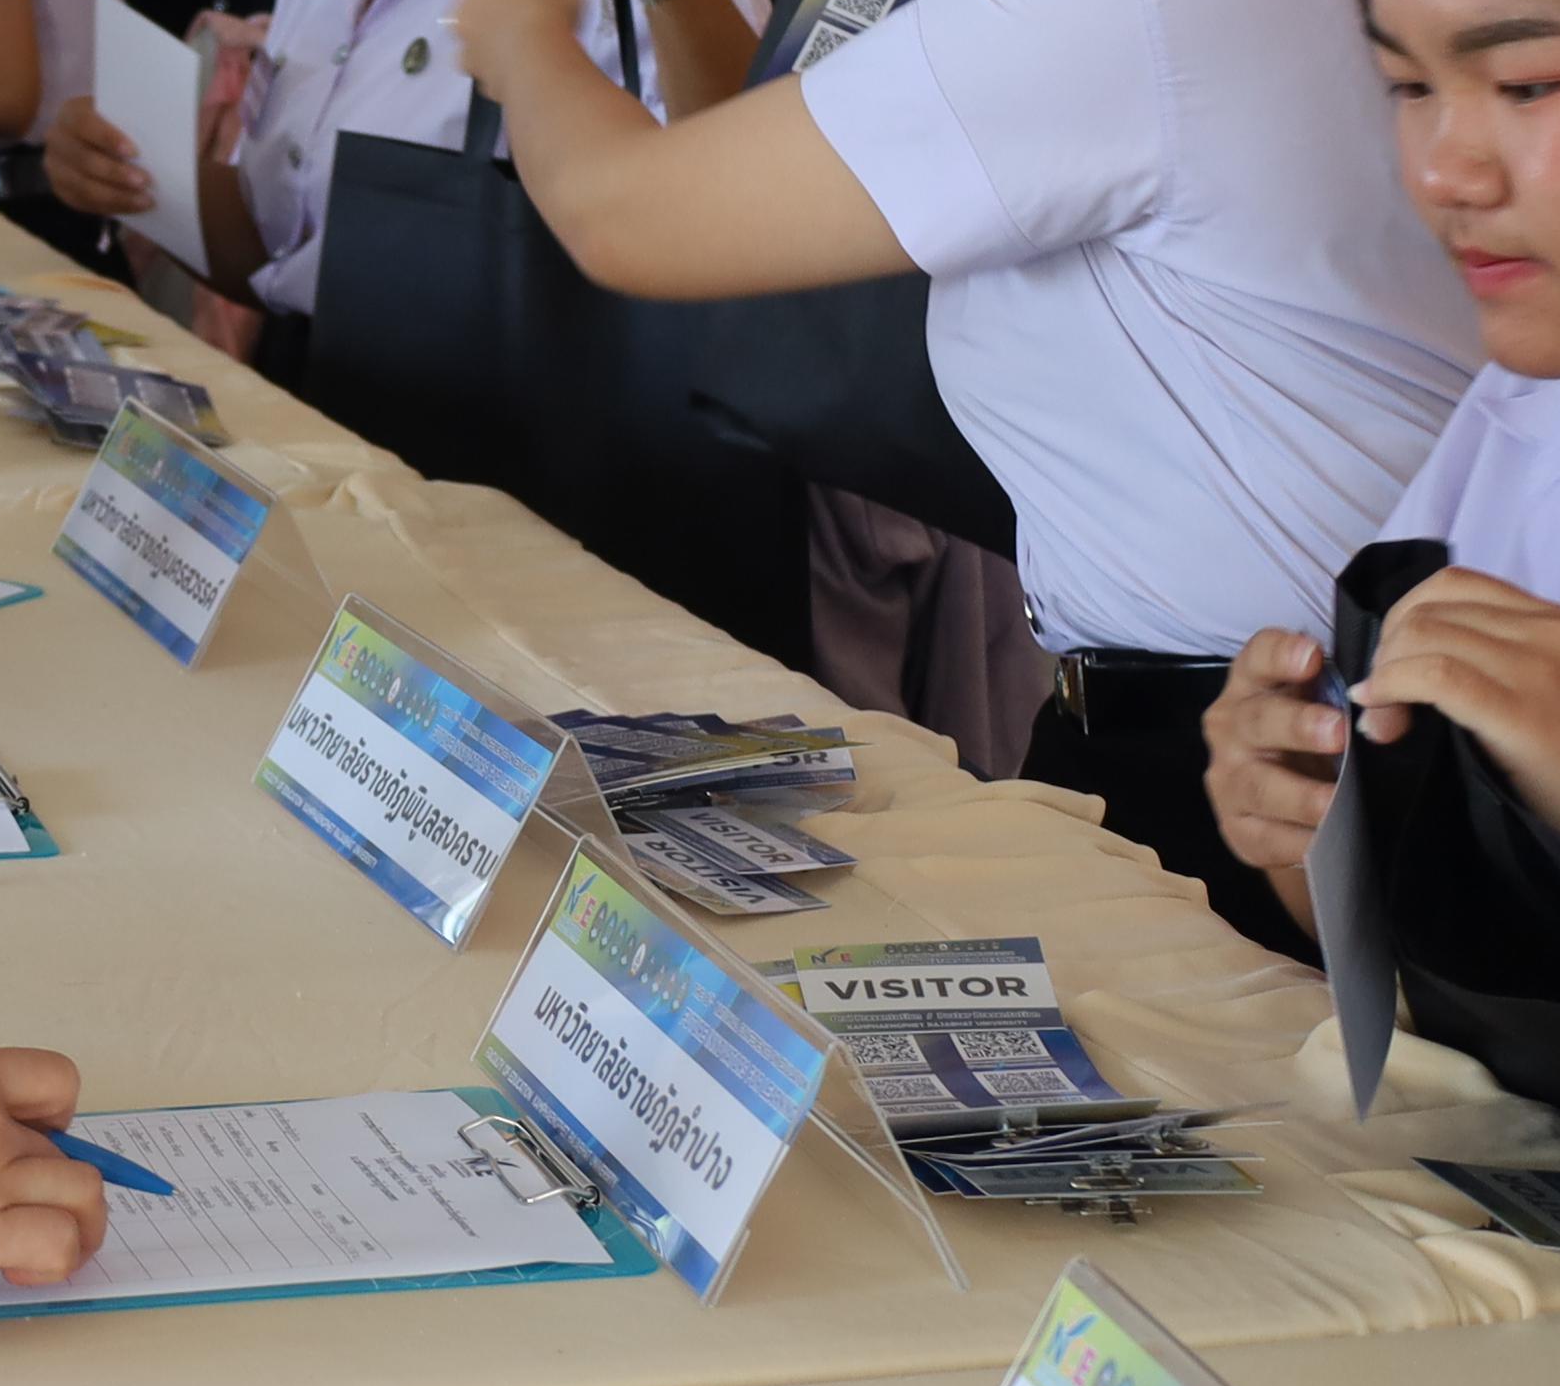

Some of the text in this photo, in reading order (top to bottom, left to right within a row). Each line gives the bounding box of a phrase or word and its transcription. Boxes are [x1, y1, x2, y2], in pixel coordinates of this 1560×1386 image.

[286, 702, 499, 880] มหาวิทยาลัยราชภัฏพิบูลสงคราม
[688, 810, 795, 865] VISITOR
[644, 839, 768, 905] VISITOR
[824, 976, 1030, 1001] VISITOR
[534, 984, 735, 1191] มหาวิทยาลัยราชภัฏลำปาง
